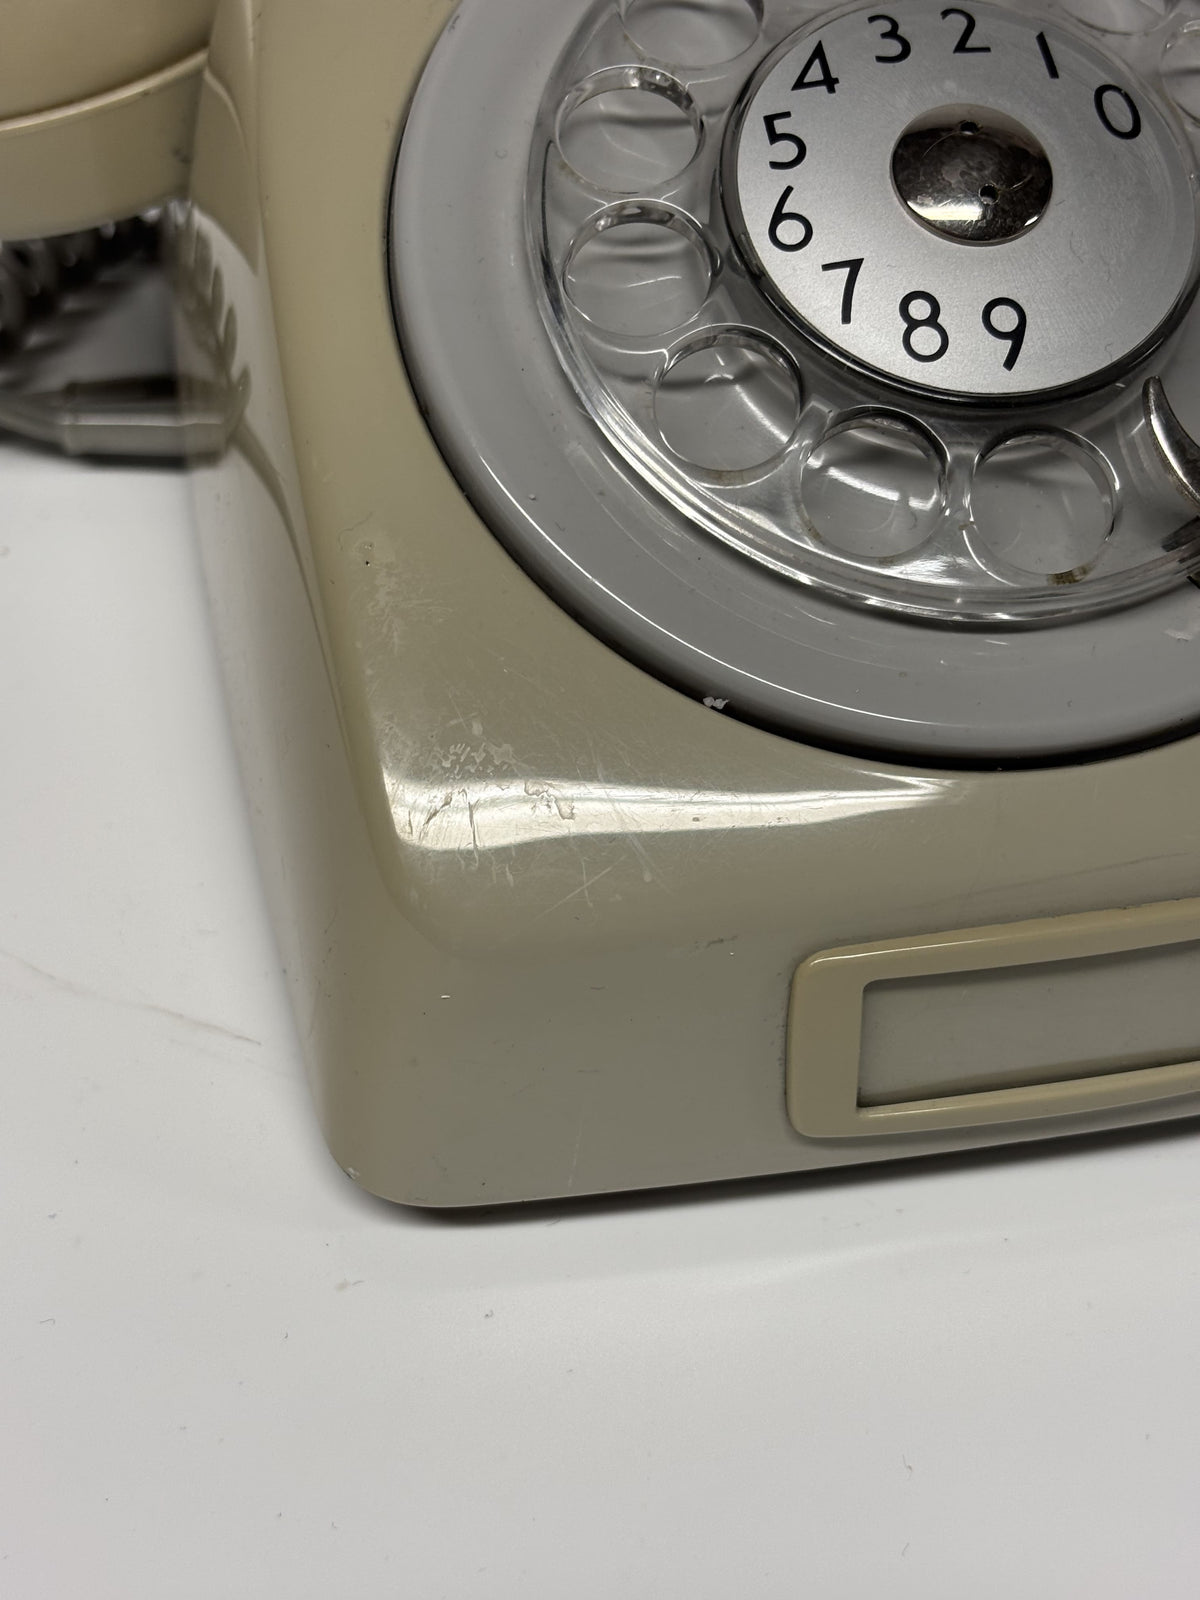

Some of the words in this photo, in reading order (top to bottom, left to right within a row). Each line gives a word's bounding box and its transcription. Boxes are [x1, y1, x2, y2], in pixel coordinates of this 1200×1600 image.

[867, 13, 912, 64] 3
[939, 6, 992, 55] 2
[1035, 30, 1060, 80] 1
[790, 39, 840, 95] 4
[762, 110, 807, 170] 5
[1093, 83, 1142, 141] 0
[768, 185, 814, 252] 6
[821, 257, 865, 324] 7
[898, 290, 949, 363] 8
[981, 296, 1027, 372] 9
